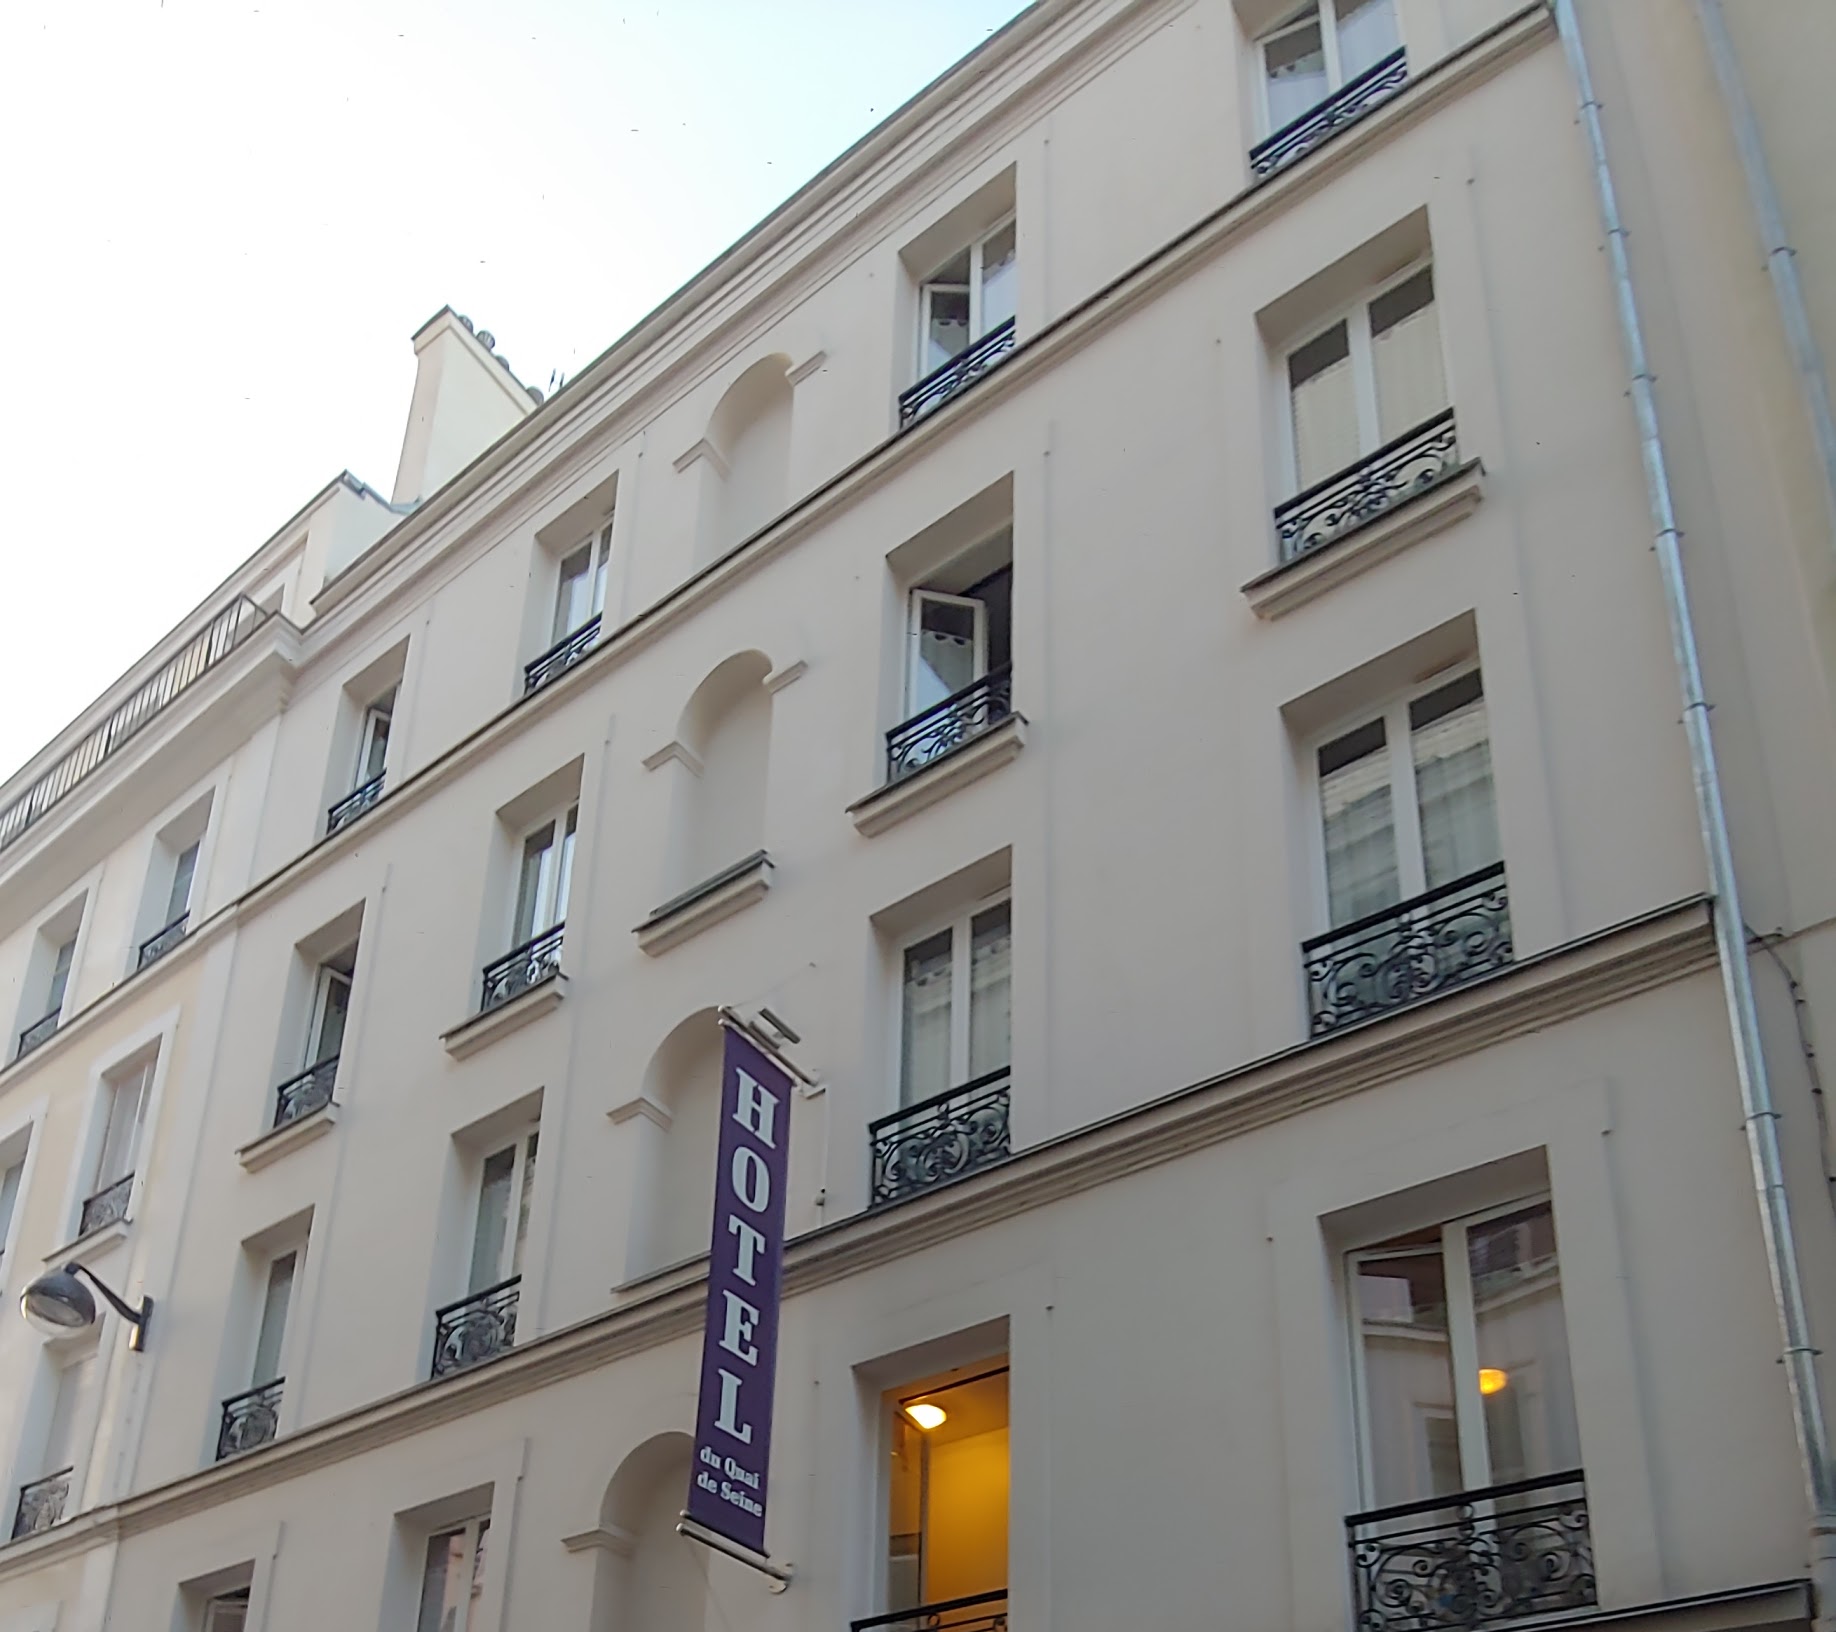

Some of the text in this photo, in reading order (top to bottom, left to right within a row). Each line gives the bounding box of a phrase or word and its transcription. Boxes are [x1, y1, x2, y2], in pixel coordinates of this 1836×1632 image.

[713, 1067, 780, 1445] HOTEL
[700, 1446, 759, 1490] du Quai
[697, 1471, 763, 1517] de Seine
